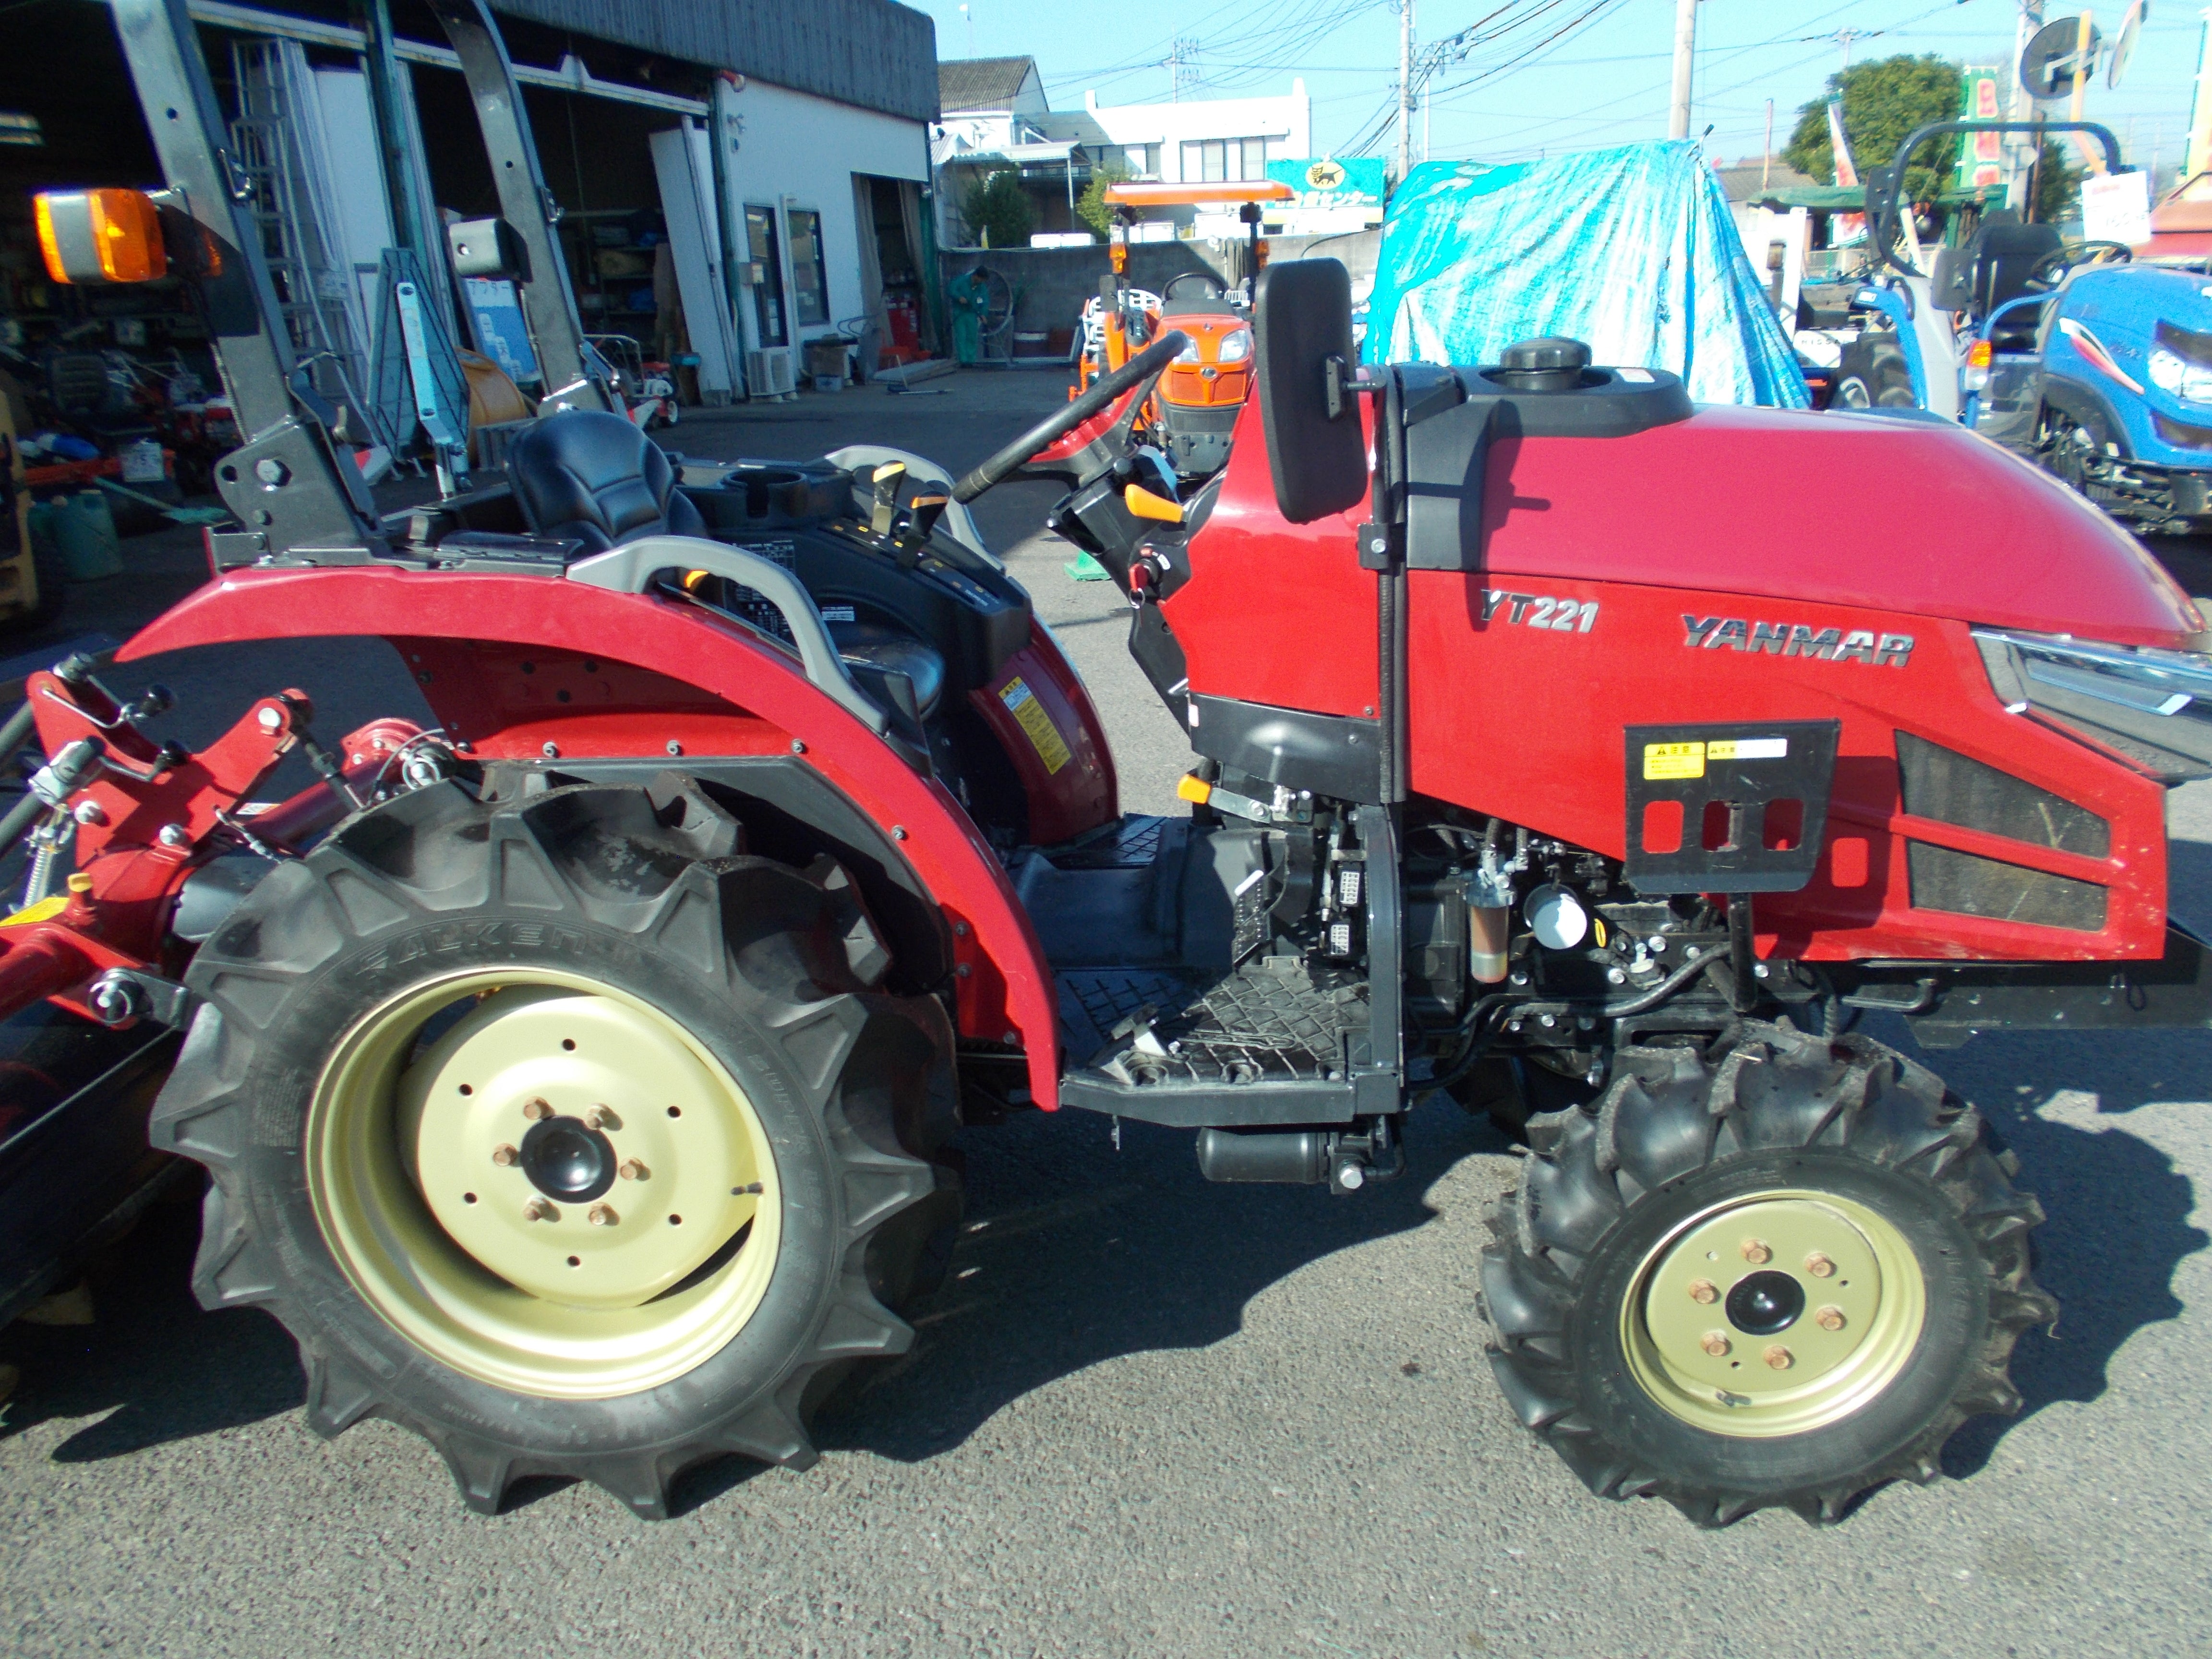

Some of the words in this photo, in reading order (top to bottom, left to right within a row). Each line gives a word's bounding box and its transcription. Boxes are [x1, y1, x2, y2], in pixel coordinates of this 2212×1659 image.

[1274, 191, 1378, 208] センター
[1480, 589, 1600, 633] YT221
[1681, 614, 1915, 668] YANMAR
[354, 921, 588, 978] FALKEN
